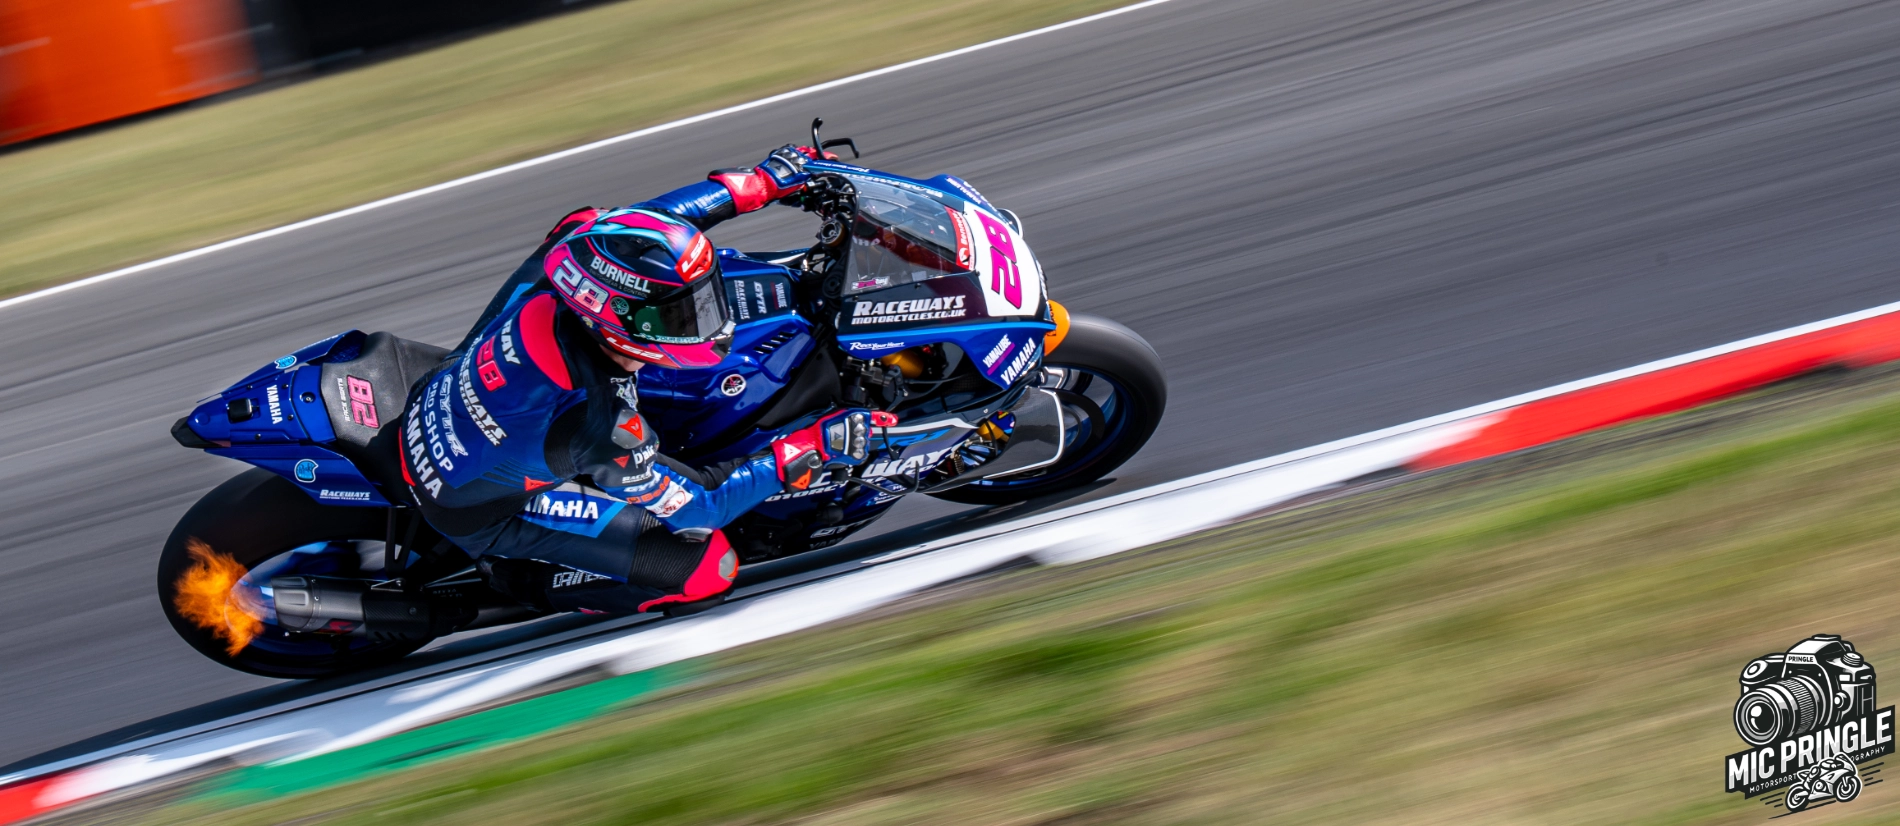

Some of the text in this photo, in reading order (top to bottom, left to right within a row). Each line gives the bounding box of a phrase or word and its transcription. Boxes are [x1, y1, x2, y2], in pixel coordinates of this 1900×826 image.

[590, 255, 651, 294] BURNELL
[974, 209, 1022, 310] 28
[552, 257, 609, 313] 28
[753, 281, 767, 314] GYTR
[851, 308, 967, 325] MOTORCYCLES.CO.UK
[853, 295, 966, 317] RACEWAYS
[501, 318, 521, 365] RAY
[606, 336, 664, 361] LS2
[982, 333, 1012, 368] YAMALUBE
[1000, 337, 1036, 385] YAMAHA
[476, 335, 507, 392] 28
[266, 384, 283, 425] YAMAHA
[346, 374, 380, 430] 28
[439, 373, 469, 457] GYTR
[425, 381, 454, 472] PRO SHOP
[320, 489, 371, 498] RACEWAYS
[525, 493, 599, 519] MAHA
